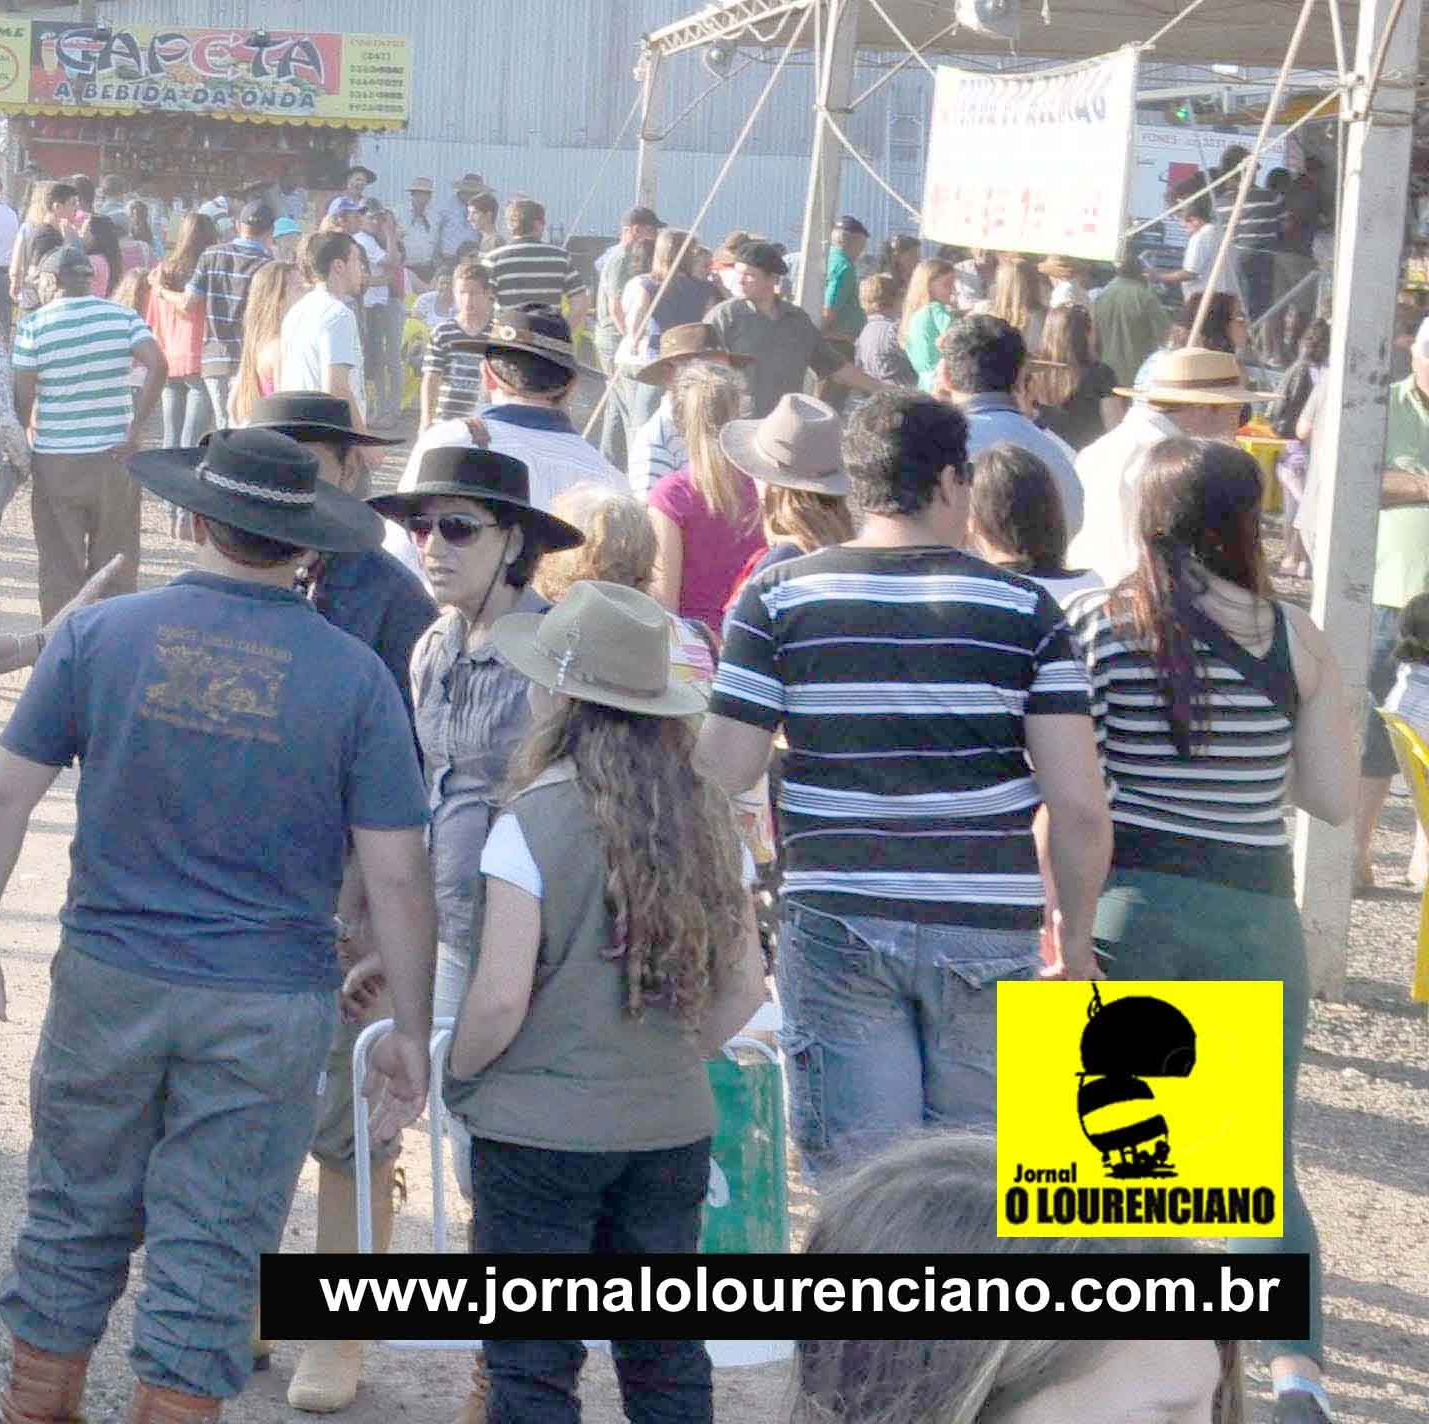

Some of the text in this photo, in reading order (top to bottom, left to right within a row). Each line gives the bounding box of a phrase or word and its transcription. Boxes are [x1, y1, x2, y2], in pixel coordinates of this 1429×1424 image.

[53, 81, 316, 109] A BEBIDA DA ONDA
